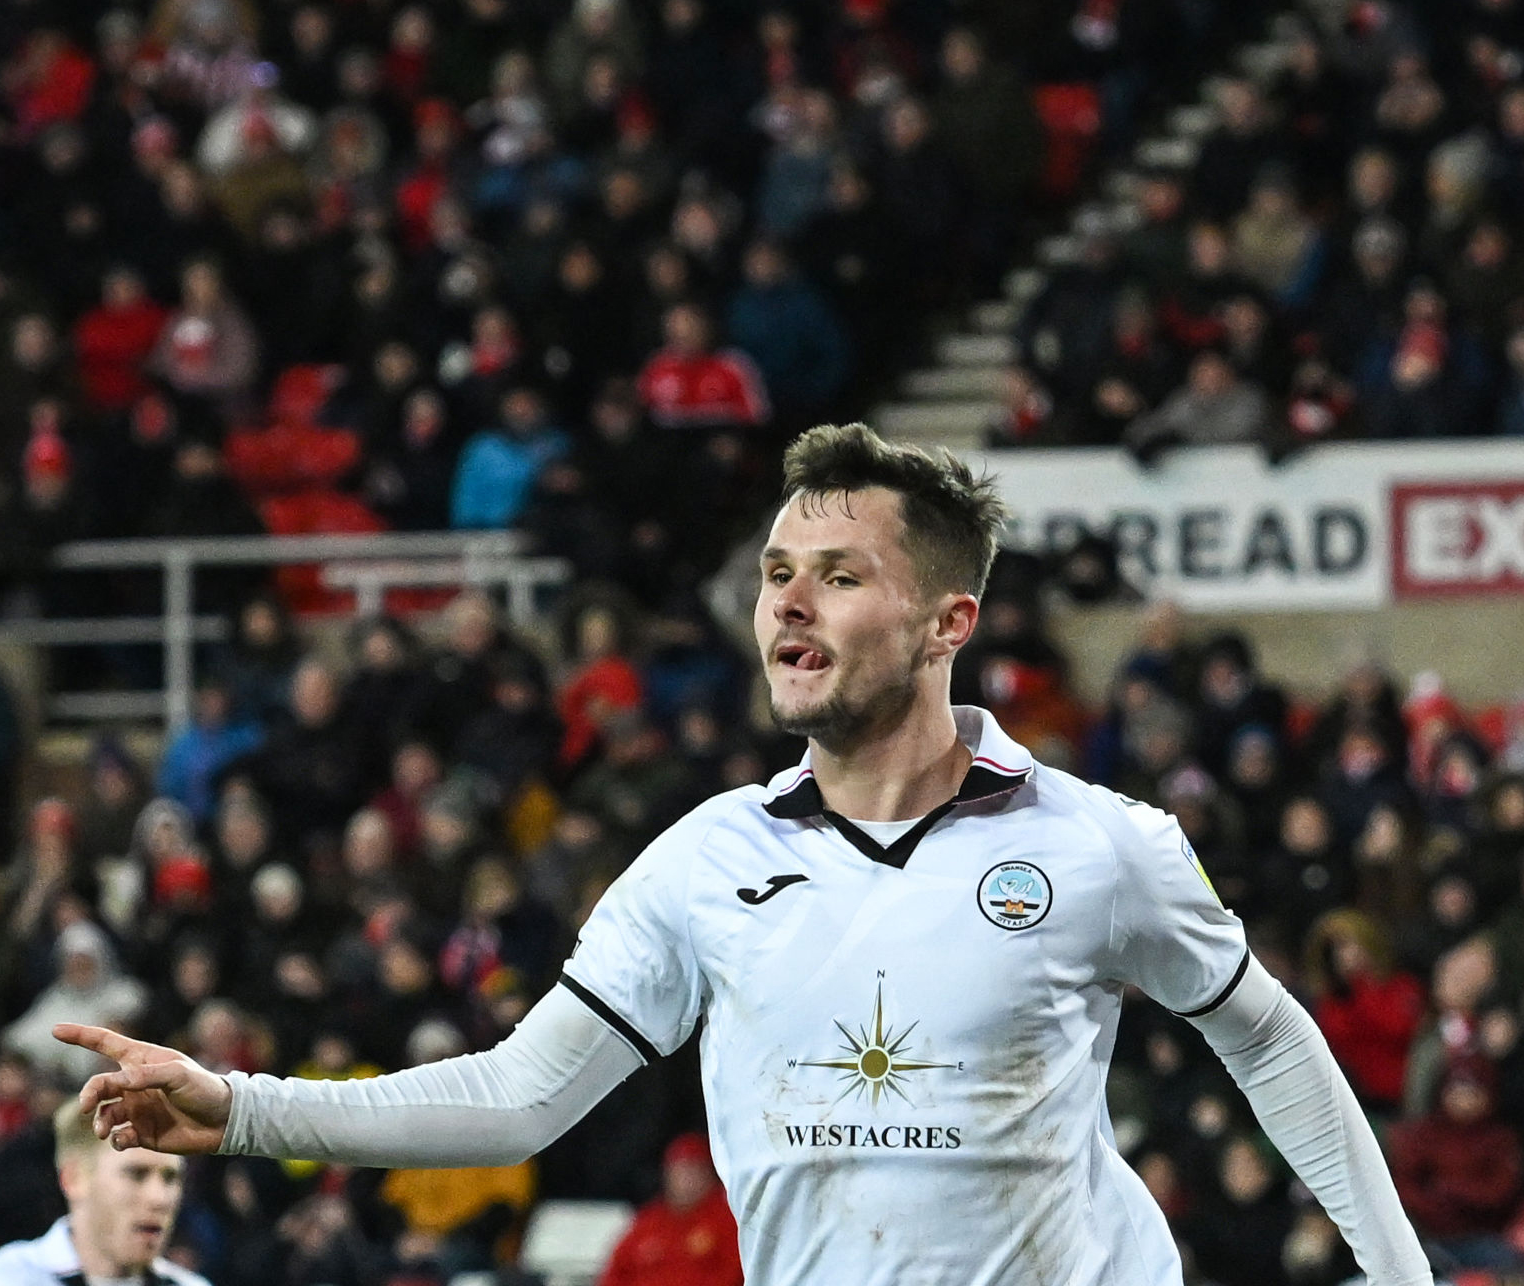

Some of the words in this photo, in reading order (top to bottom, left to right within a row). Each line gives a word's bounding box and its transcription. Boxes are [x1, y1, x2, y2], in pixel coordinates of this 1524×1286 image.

[1012, 504, 1370, 580] PREAD
[1000, 865, 1032, 874] SWANSEA
[995, 914, 1011, 926] CITY
[877, 969, 886, 979] N
[787, 1059, 798, 1069] W
[958, 1061, 965, 1071] E
[785, 1125, 962, 1150] WESTACRES
